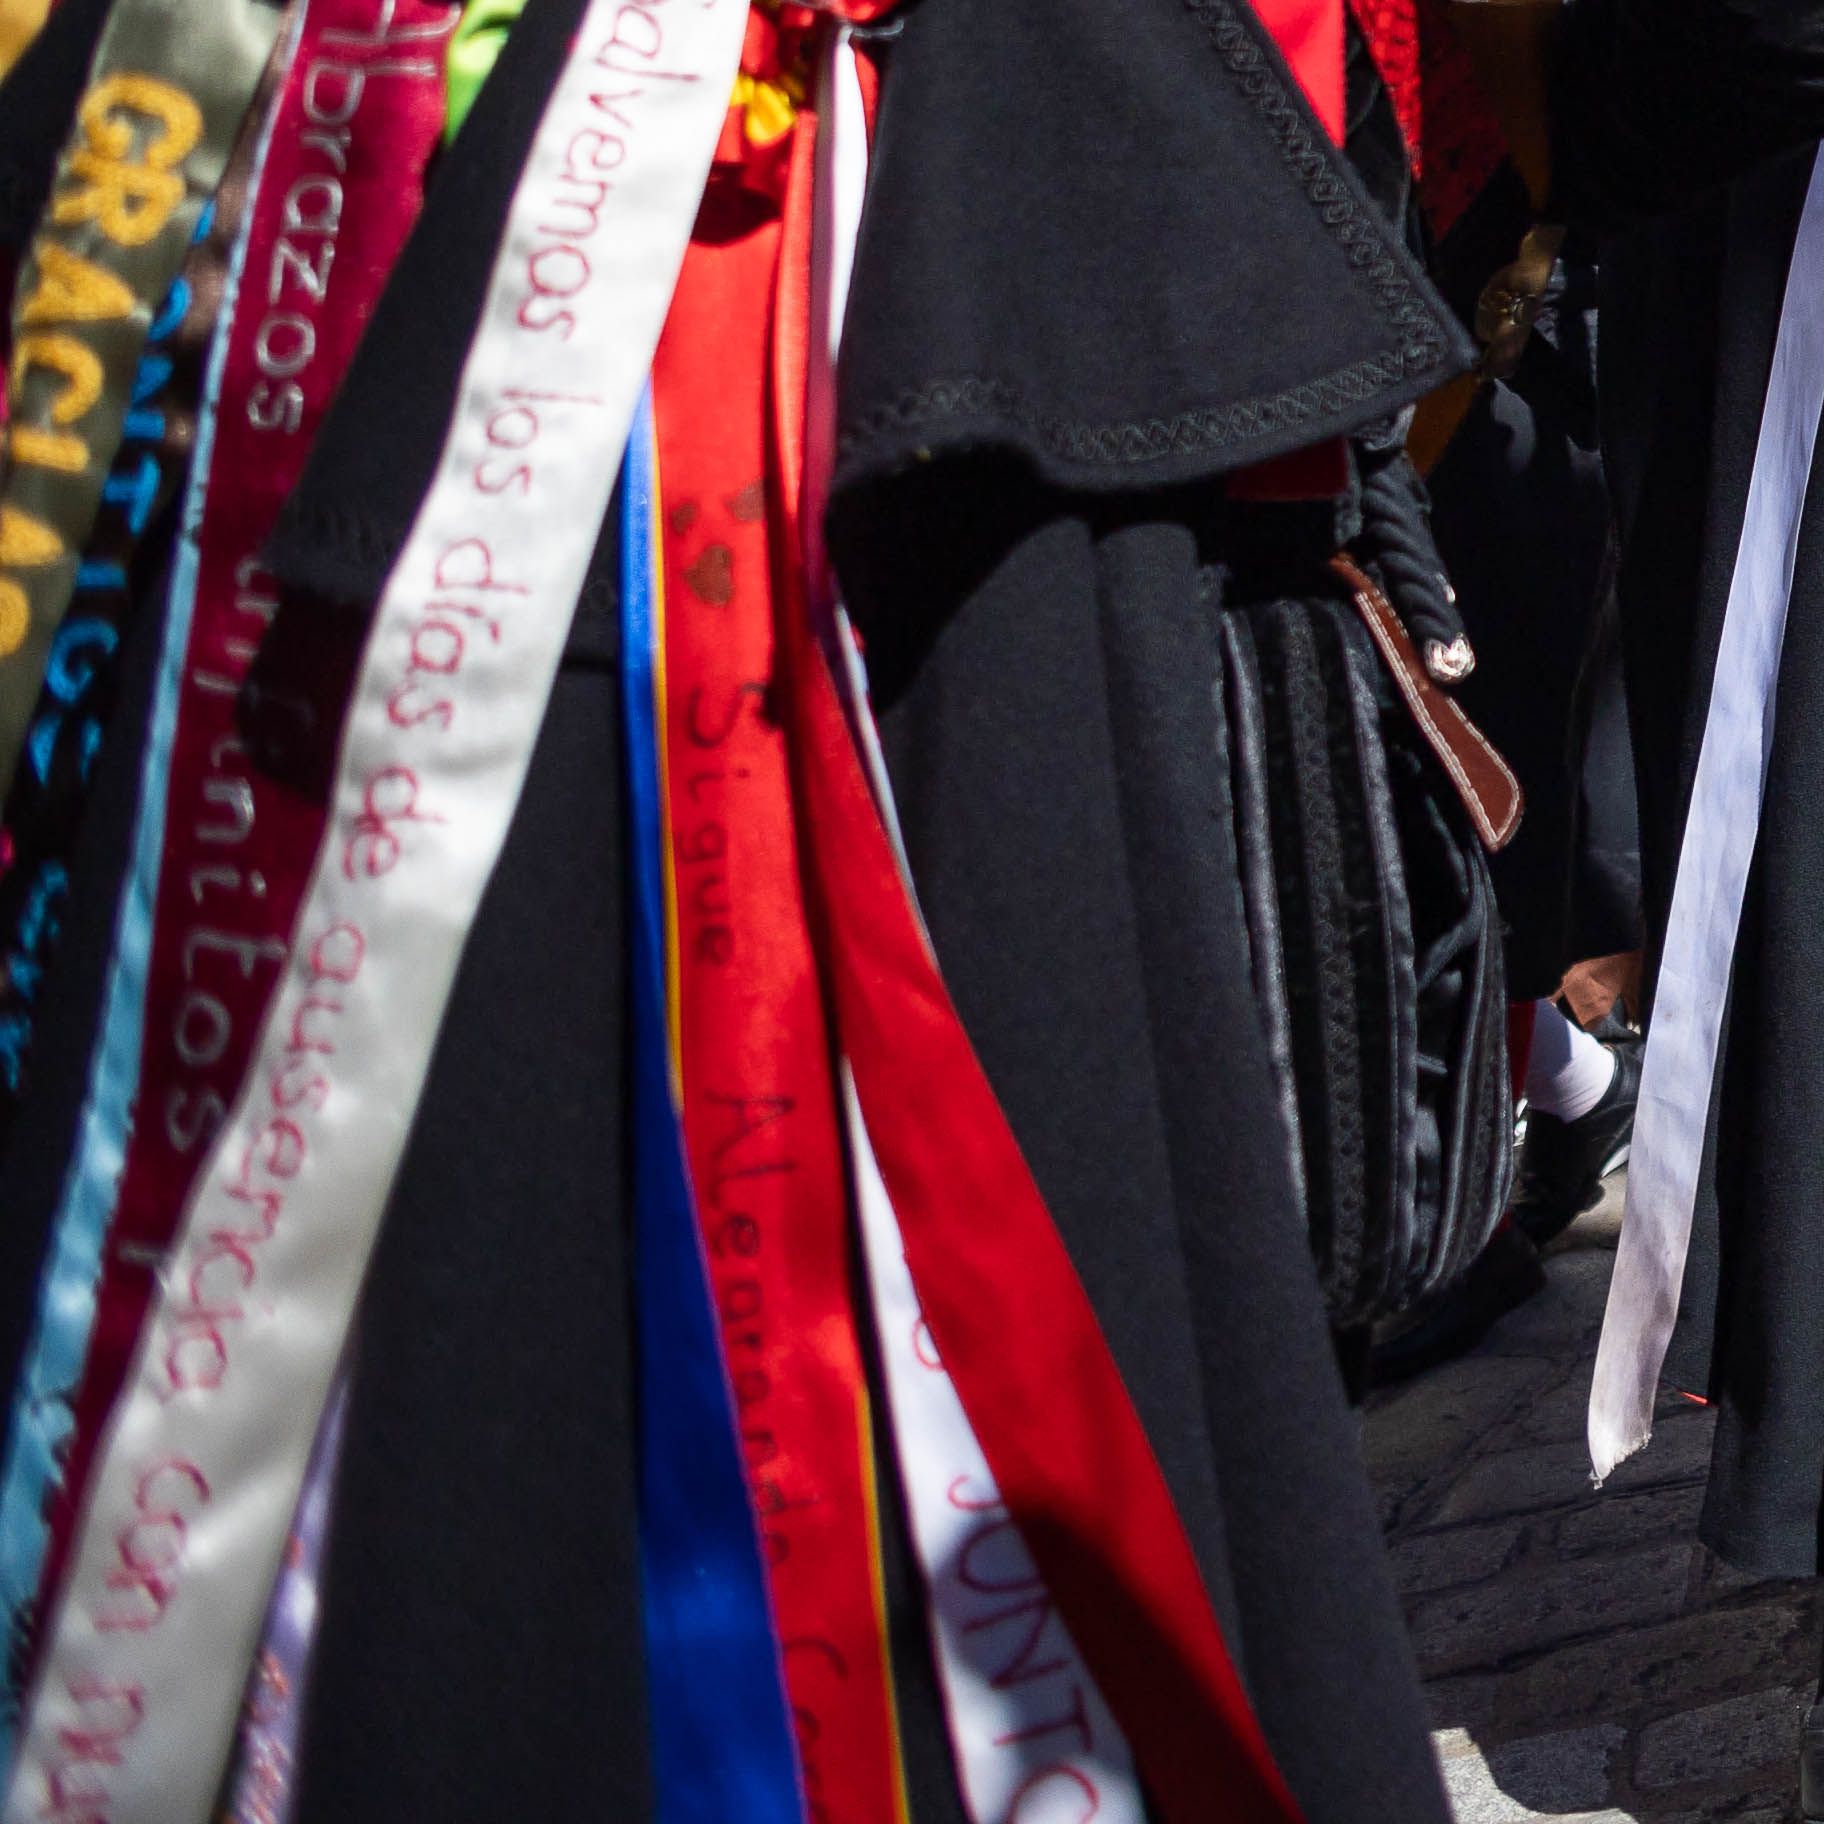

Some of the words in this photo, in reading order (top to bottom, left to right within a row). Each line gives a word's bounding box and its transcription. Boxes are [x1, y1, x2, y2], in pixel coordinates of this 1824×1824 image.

[29, 197, 214, 785] ONTIGO
[474, 386, 604, 498] los
[387, 535, 530, 732] días
[342, 767, 446, 881] de
[680, 680, 771, 969] Sigue
[92, 1456, 210, 1633] con
